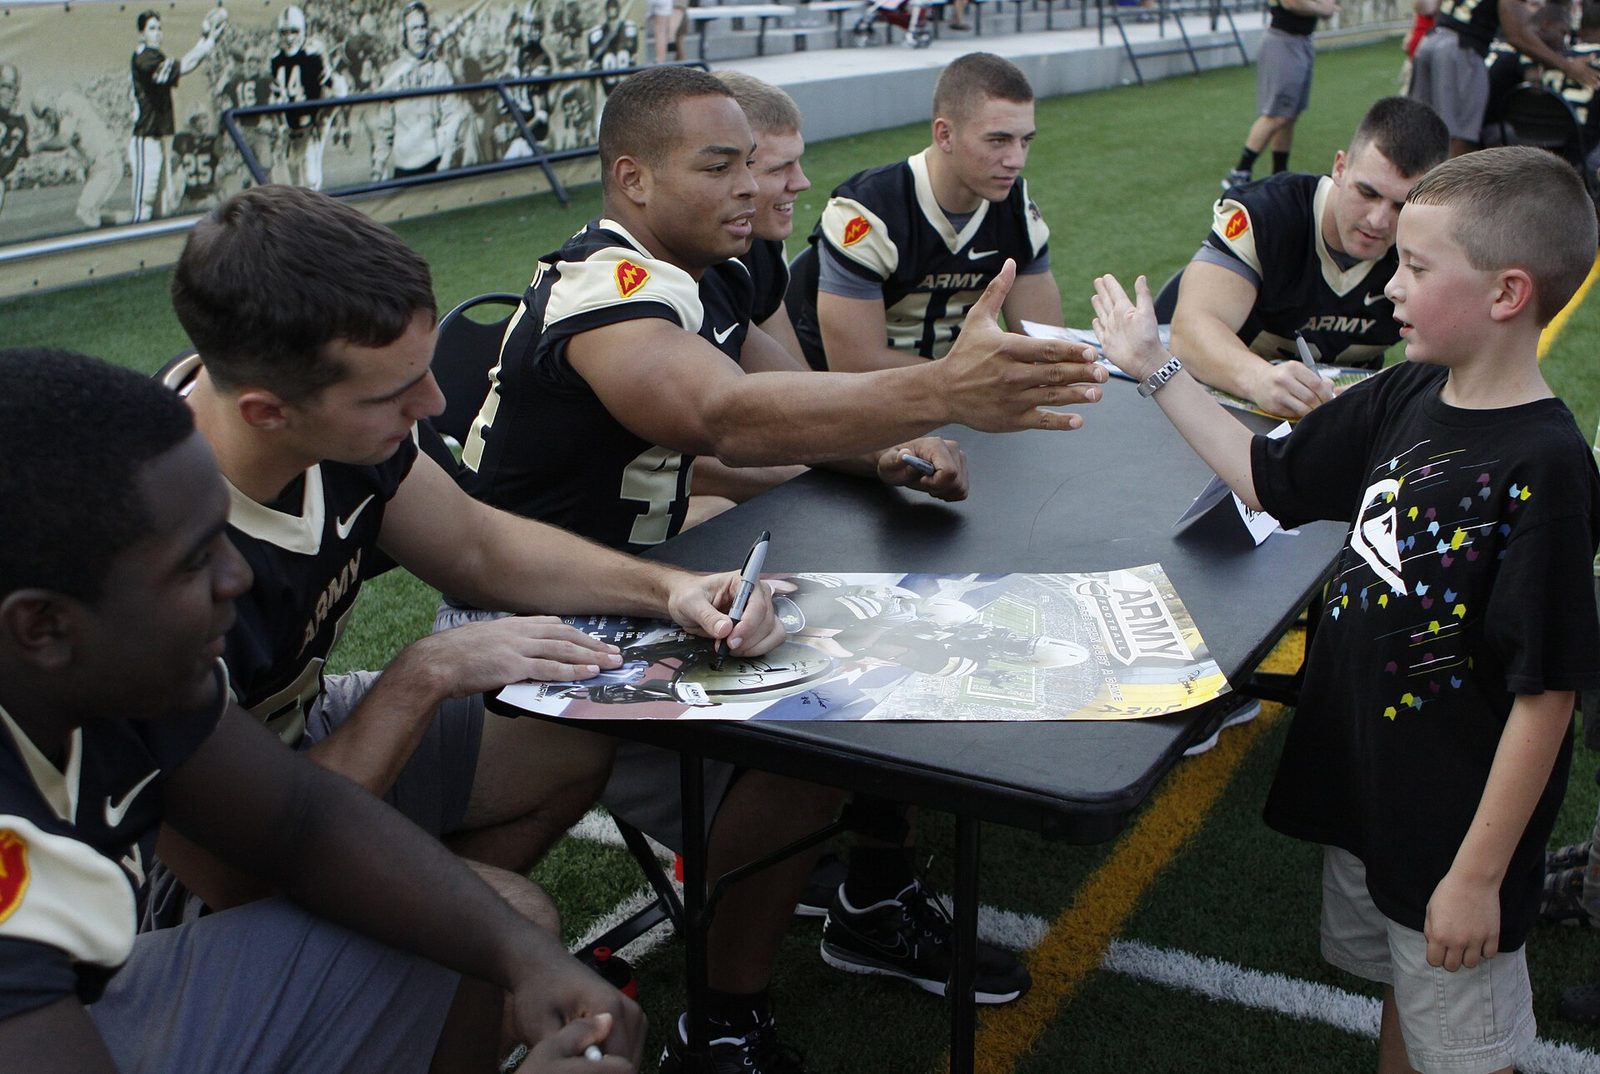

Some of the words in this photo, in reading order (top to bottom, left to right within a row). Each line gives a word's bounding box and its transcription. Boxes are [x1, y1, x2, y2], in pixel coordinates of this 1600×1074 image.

[916, 272, 984, 289] ARMY
[1300, 315, 1377, 334] ARMY
[296, 546, 362, 660] ARMY
[1098, 598, 1127, 652] FOOTBALL
[1112, 587, 1185, 656] ARMY
